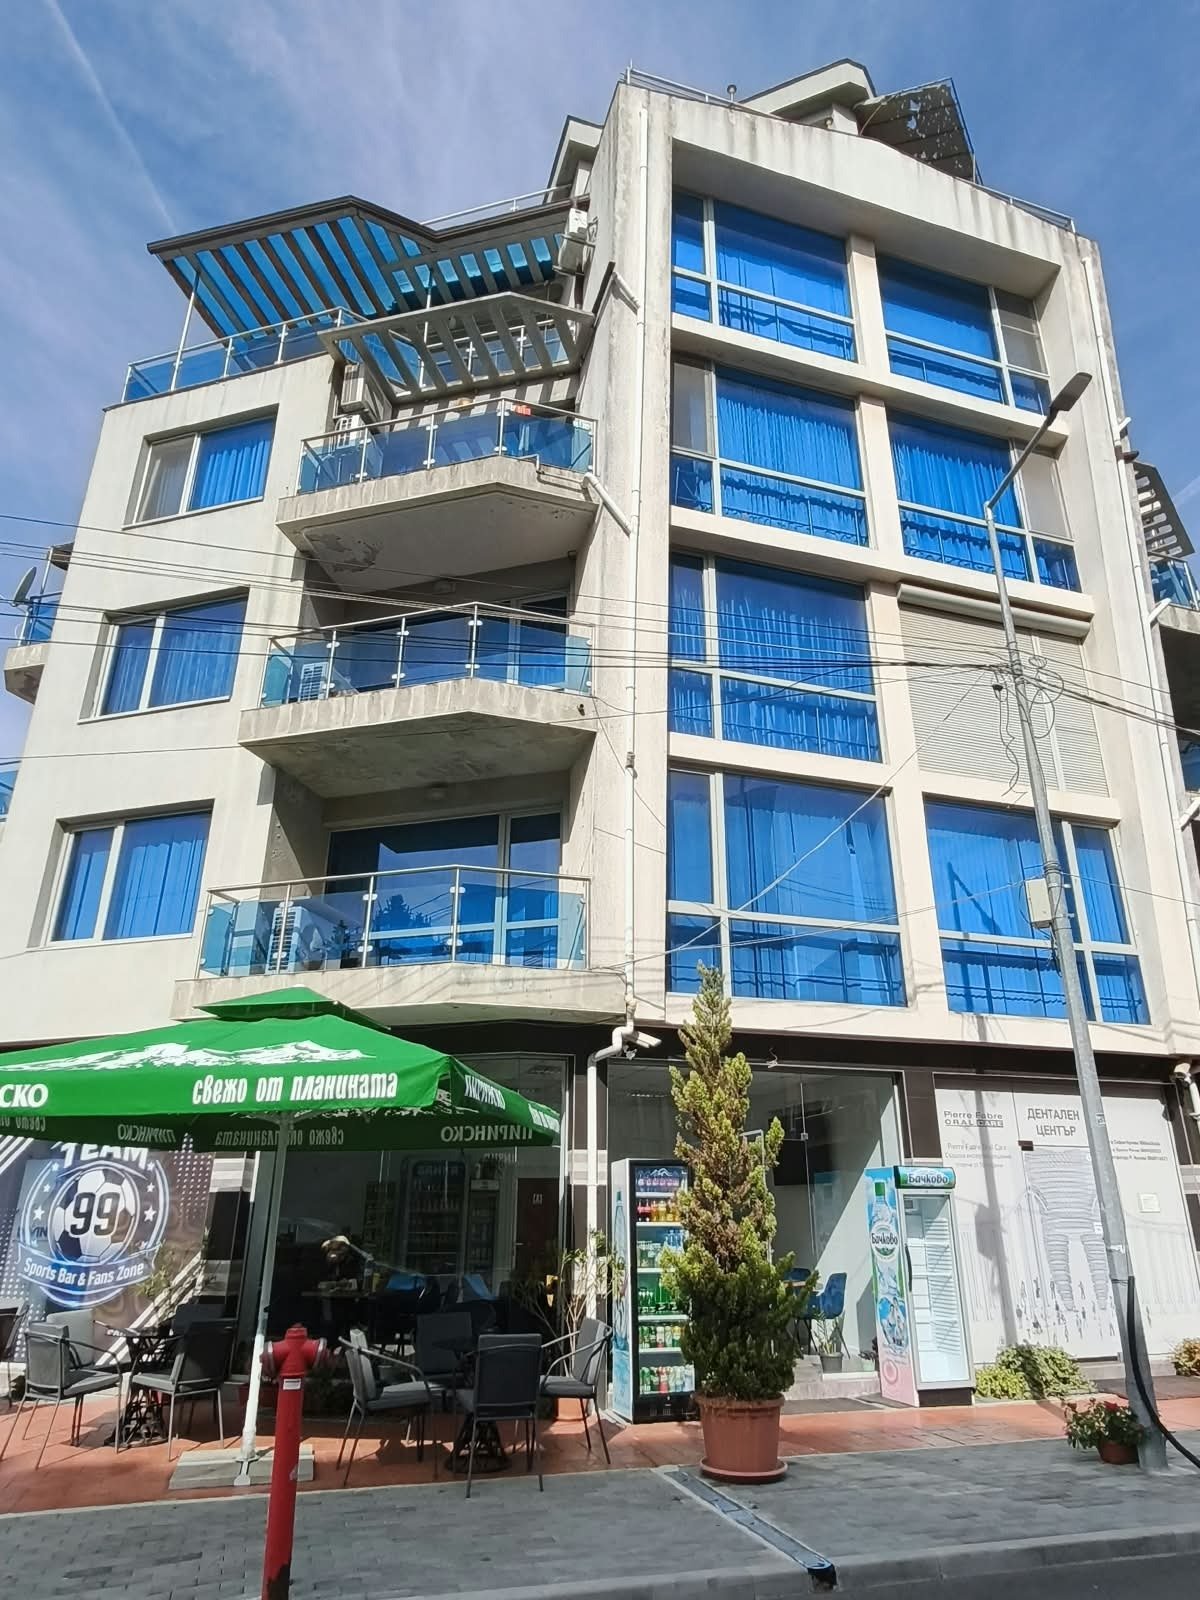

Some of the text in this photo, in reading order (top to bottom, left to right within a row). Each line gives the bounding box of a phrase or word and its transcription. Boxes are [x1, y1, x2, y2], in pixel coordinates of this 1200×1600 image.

[192, 1072, 398, 1104] свежо от планината
[943, 1110, 1003, 1120] Pierre Fabre
[1027, 1108, 1080, 1121] ДЕНТАЛЕН
[1036, 1125, 1077, 1137] ЦЕНТЪР
[60, 1142, 149, 1169] TEAM
[908, 1173, 949, 1184] Бачково
[70, 1192, 120, 1236] 99
[871, 1232, 899, 1245] Бачково
[24, 1258, 144, 1286] Sports Bar & Fans Zone
